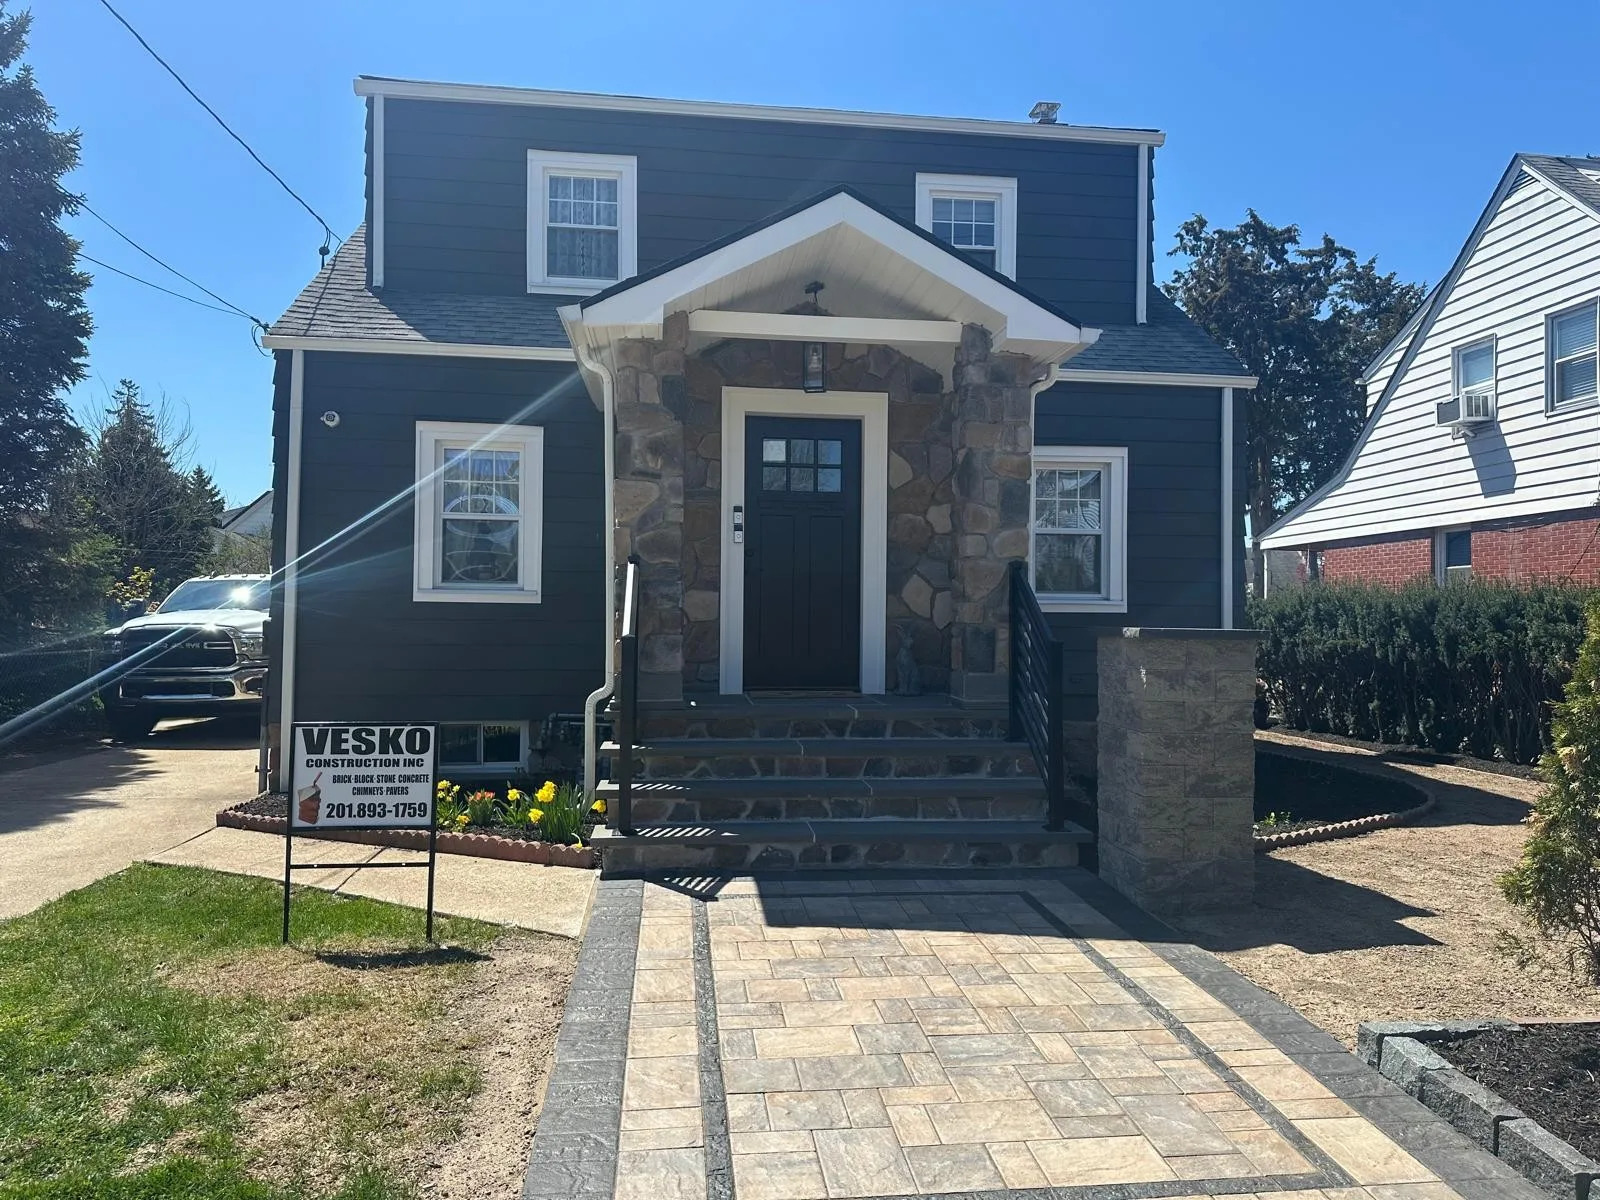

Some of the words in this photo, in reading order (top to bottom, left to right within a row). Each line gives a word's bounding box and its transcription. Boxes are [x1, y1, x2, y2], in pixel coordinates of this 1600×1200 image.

[301, 728, 431, 755] VESKO
[305, 758, 400, 768] CONSTRUCTION
[402, 758, 425, 768] INC
[398, 774, 430, 783] CONCRETE
[326, 802, 428, 818] 201.893-1759
